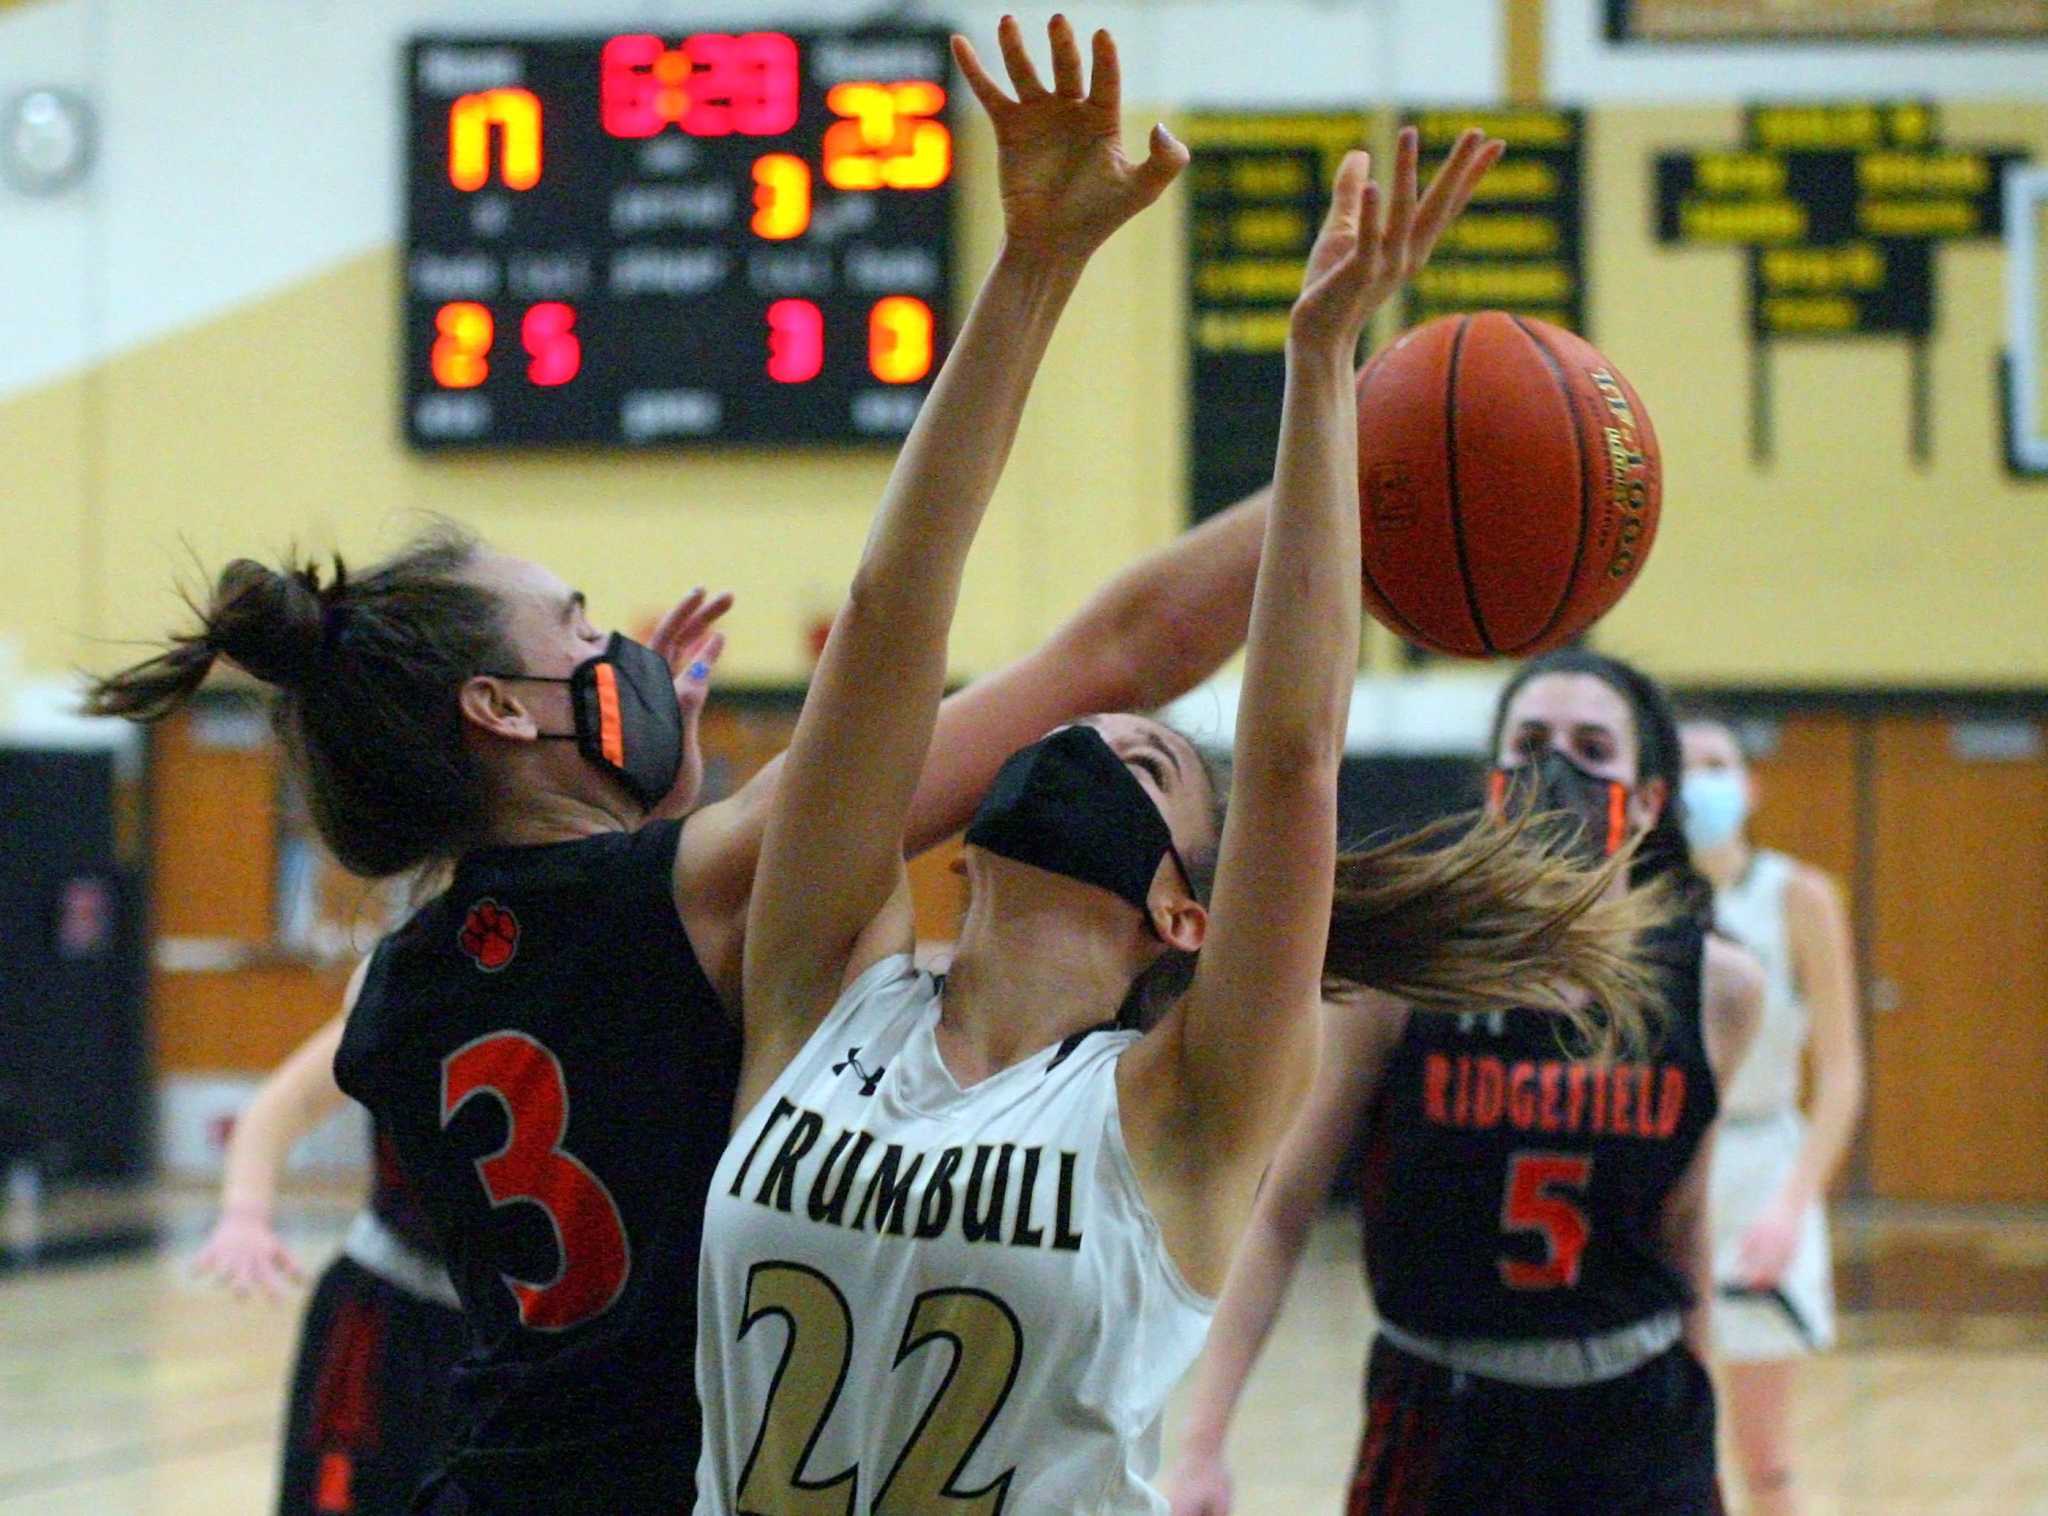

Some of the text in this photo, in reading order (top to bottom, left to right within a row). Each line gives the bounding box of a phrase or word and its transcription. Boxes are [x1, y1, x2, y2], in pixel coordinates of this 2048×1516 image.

[1423, 1053, 1688, 1138] RIDGEFIELD
[441, 1029, 631, 1332] 3
[729, 1096, 1083, 1252] TRUMBULL
[1500, 1154, 1592, 1290] 5
[736, 1260, 1025, 1516] 22
